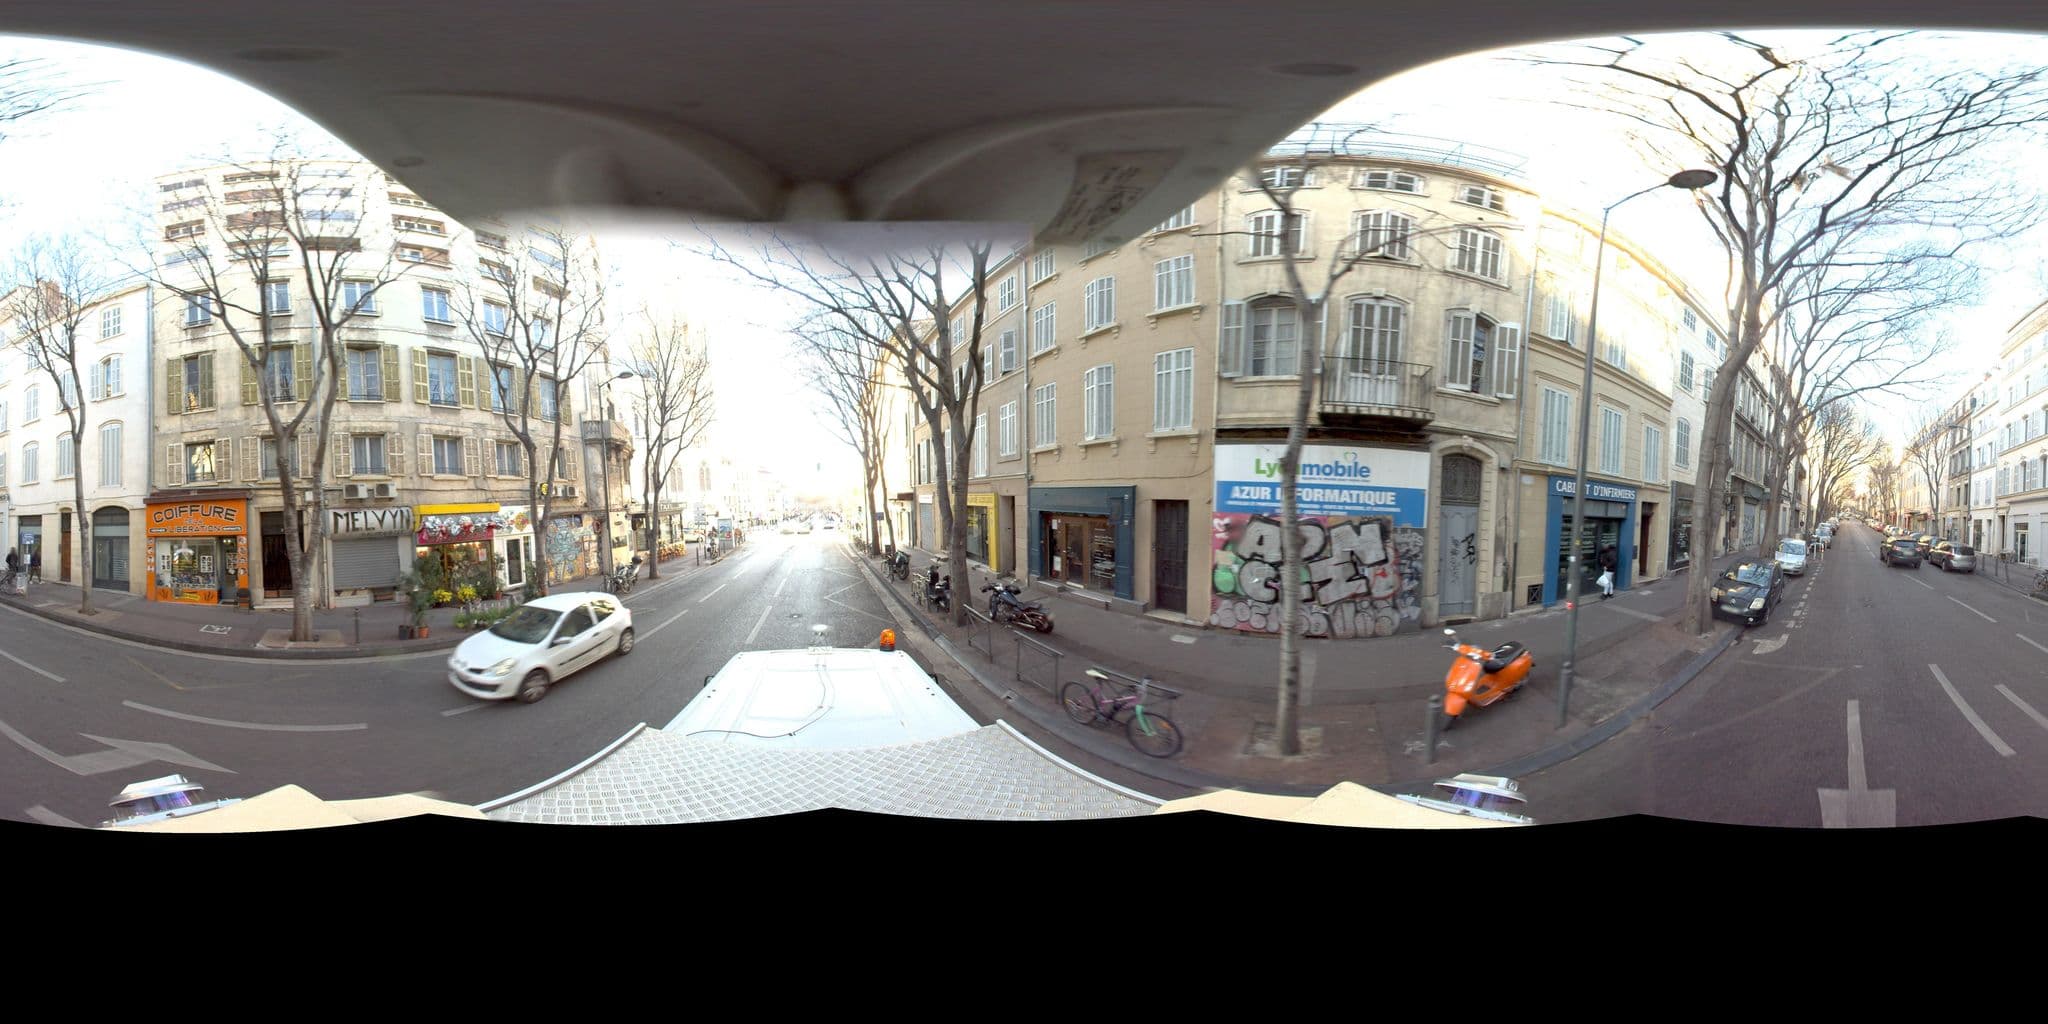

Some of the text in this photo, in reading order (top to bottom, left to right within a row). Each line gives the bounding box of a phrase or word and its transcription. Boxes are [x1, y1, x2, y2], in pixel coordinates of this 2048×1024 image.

[1255, 457, 1370, 479] Lymobile
[1231, 486, 1397, 506] AZUR IFORMATIQUE
[1556, 480, 1636, 500] CABIT D'INFIRMIERS
[153, 504, 237, 523] COIFFURE
[333, 508, 411, 534] MELVYN
